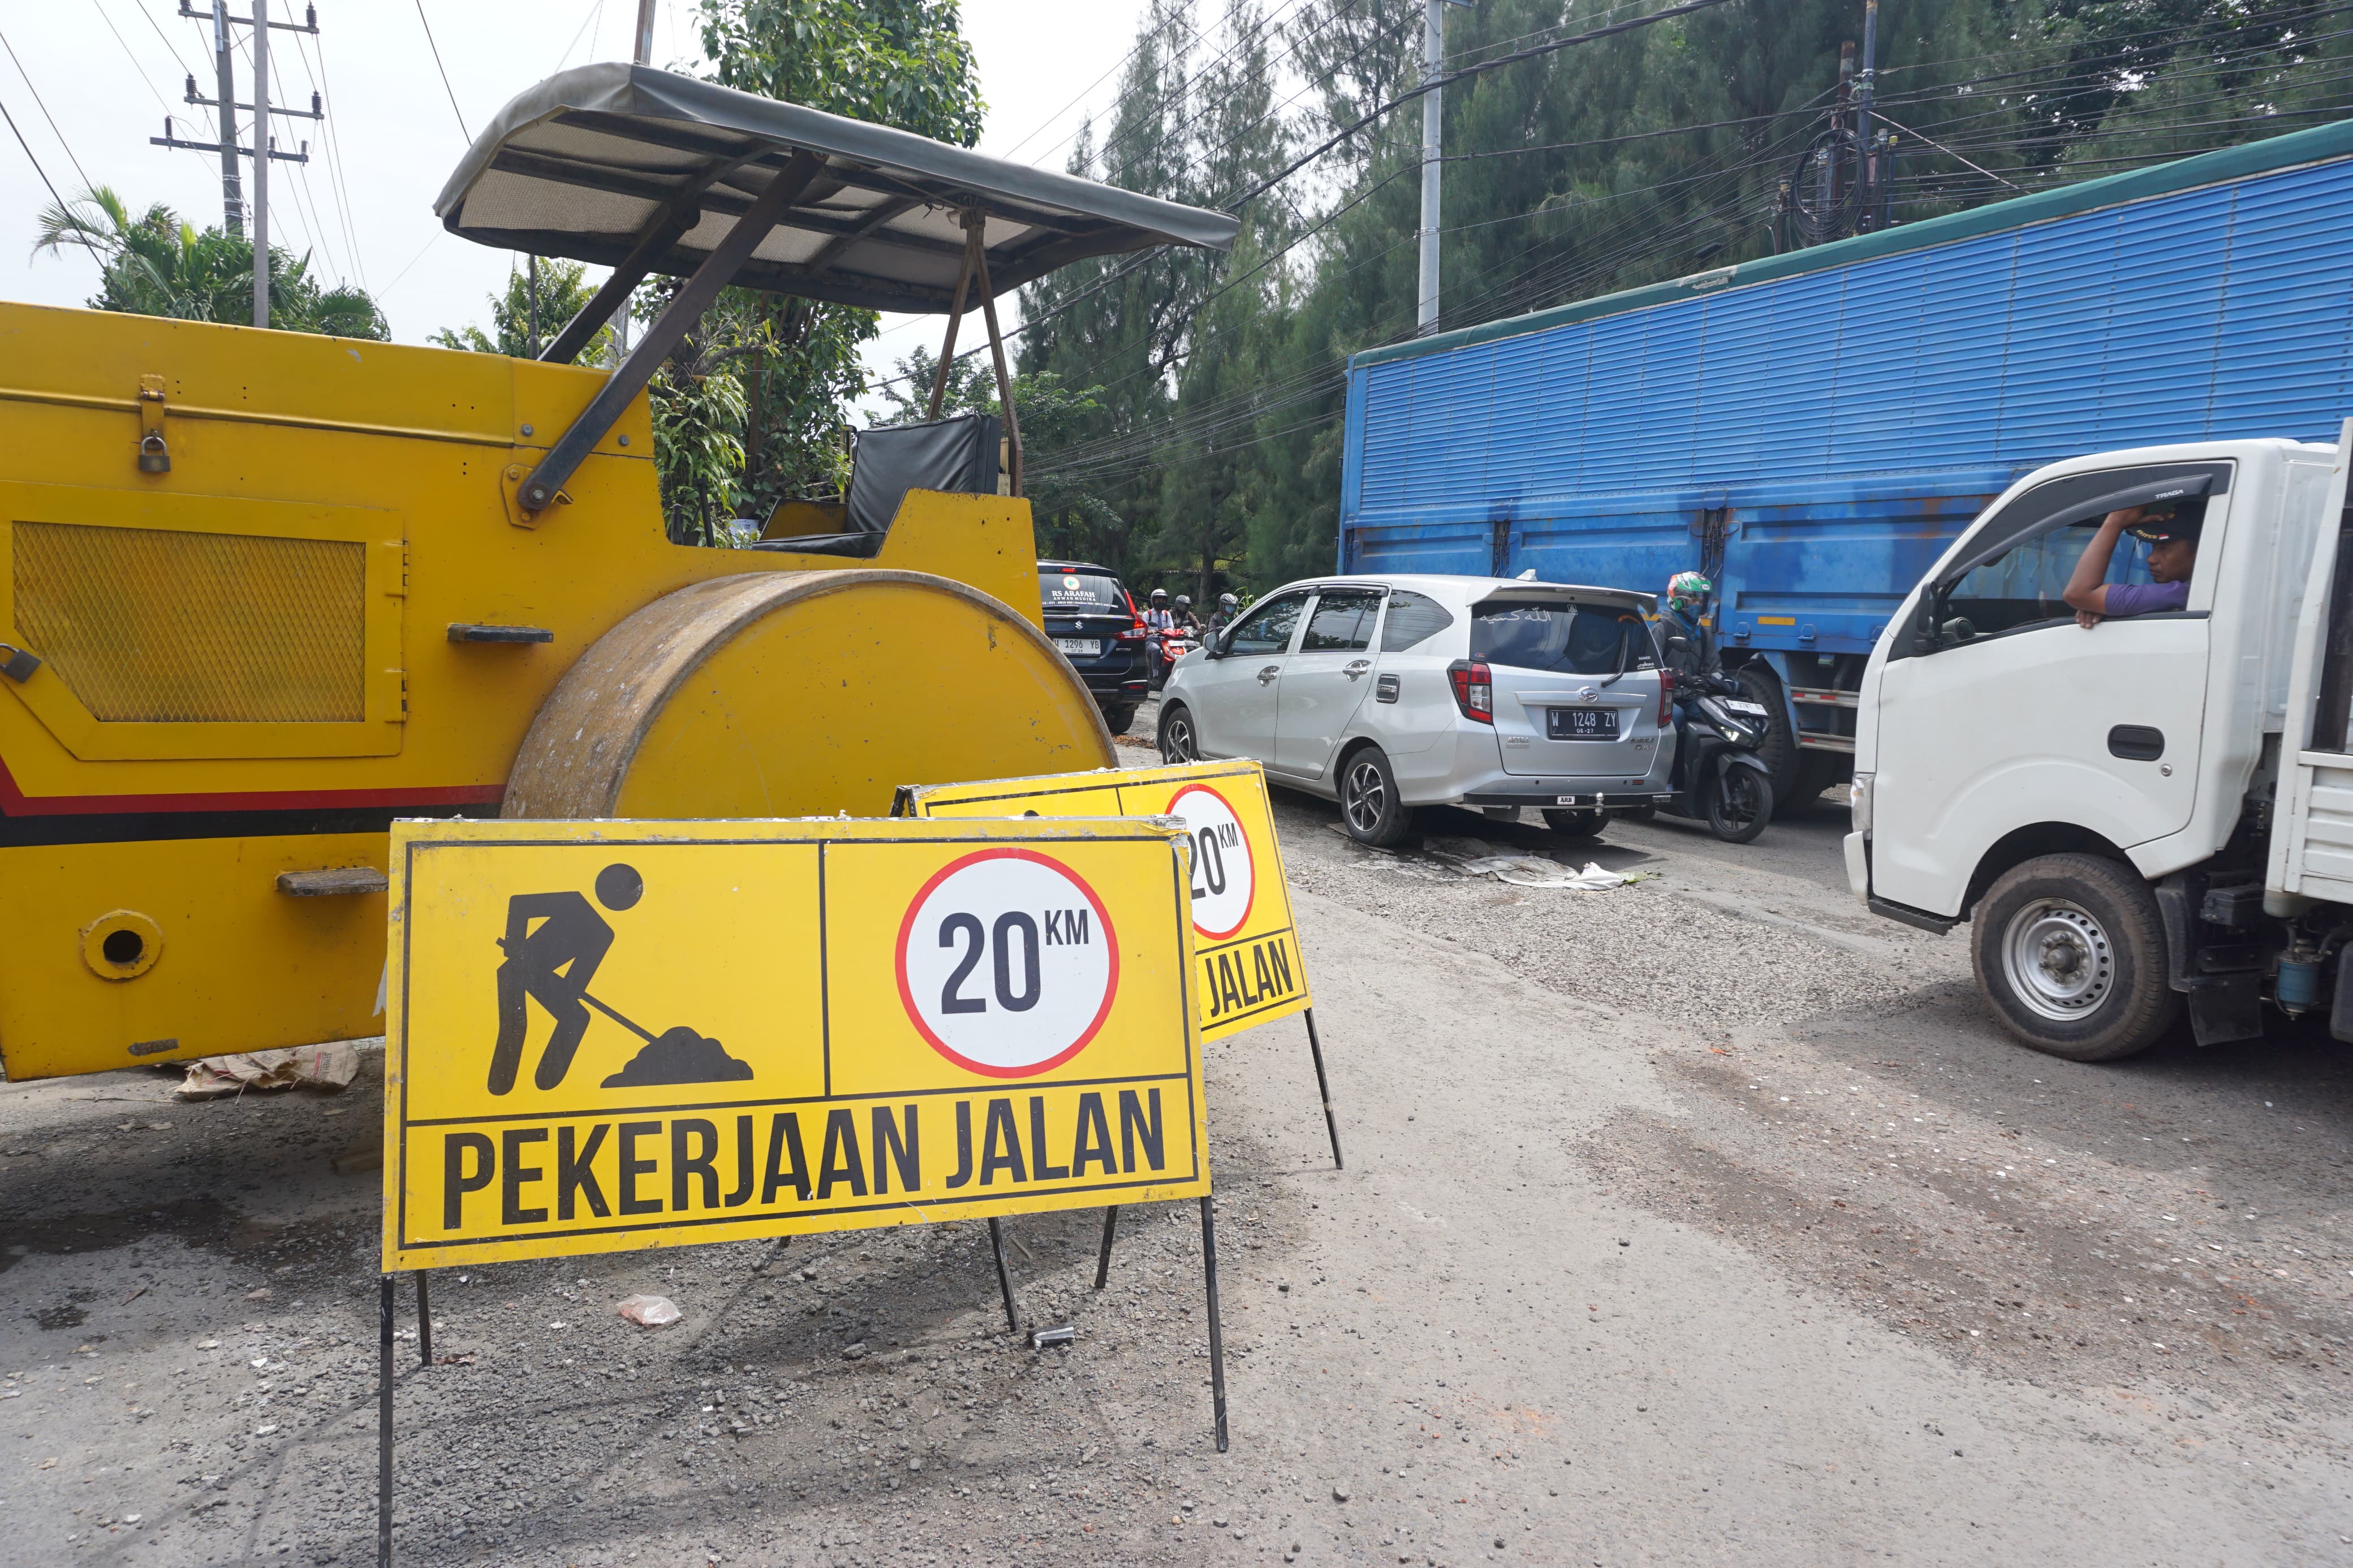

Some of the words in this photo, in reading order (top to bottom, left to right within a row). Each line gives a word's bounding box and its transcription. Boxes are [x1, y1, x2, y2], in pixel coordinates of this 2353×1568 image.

[2154, 489, 2184, 499] TRAGA
[1065, 640, 1083, 649] 1296
[1091, 640, 1100, 649] YB
[1552, 712, 1559, 727] W
[1572, 712, 1596, 727] 1248
[1604, 712, 1617, 727] ZY
[1218, 822, 1239, 849] KM
[937, 910, 1041, 1015] 20
[1045, 909, 1089, 945] KM
[1205, 938, 1294, 1018] JALAN
[443, 1104, 921, 1229] PEKERJAAN
[946, 1087, 1165, 1188] JALAN
